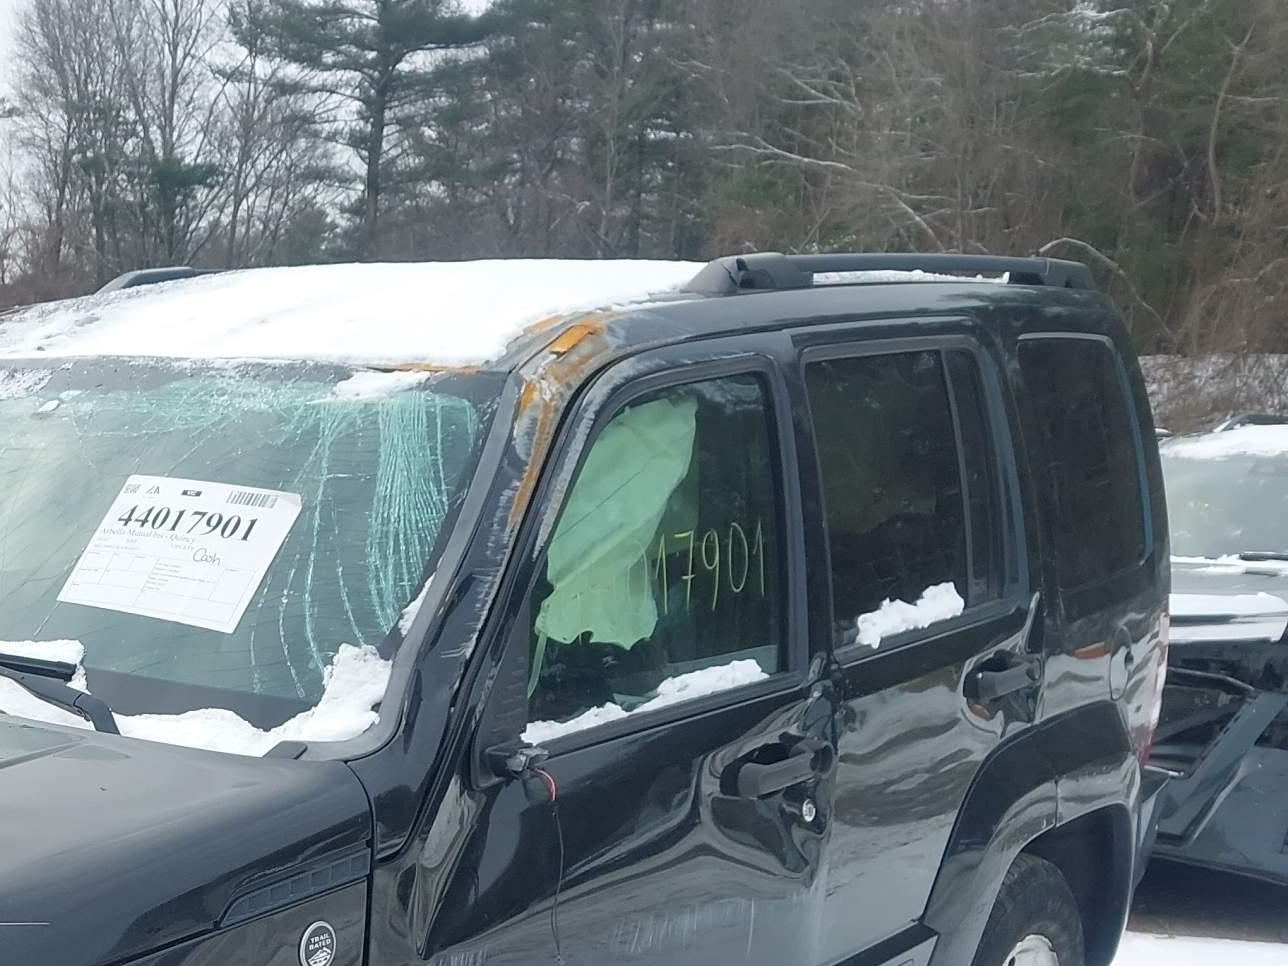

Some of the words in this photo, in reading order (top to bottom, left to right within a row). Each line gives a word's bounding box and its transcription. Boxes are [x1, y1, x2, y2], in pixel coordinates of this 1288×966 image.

[117, 504, 259, 542] 44017901
[193, 547, 221, 566] Cash
[309, 939, 331, 950] RATED
[310, 933, 330, 944] TRAIL
